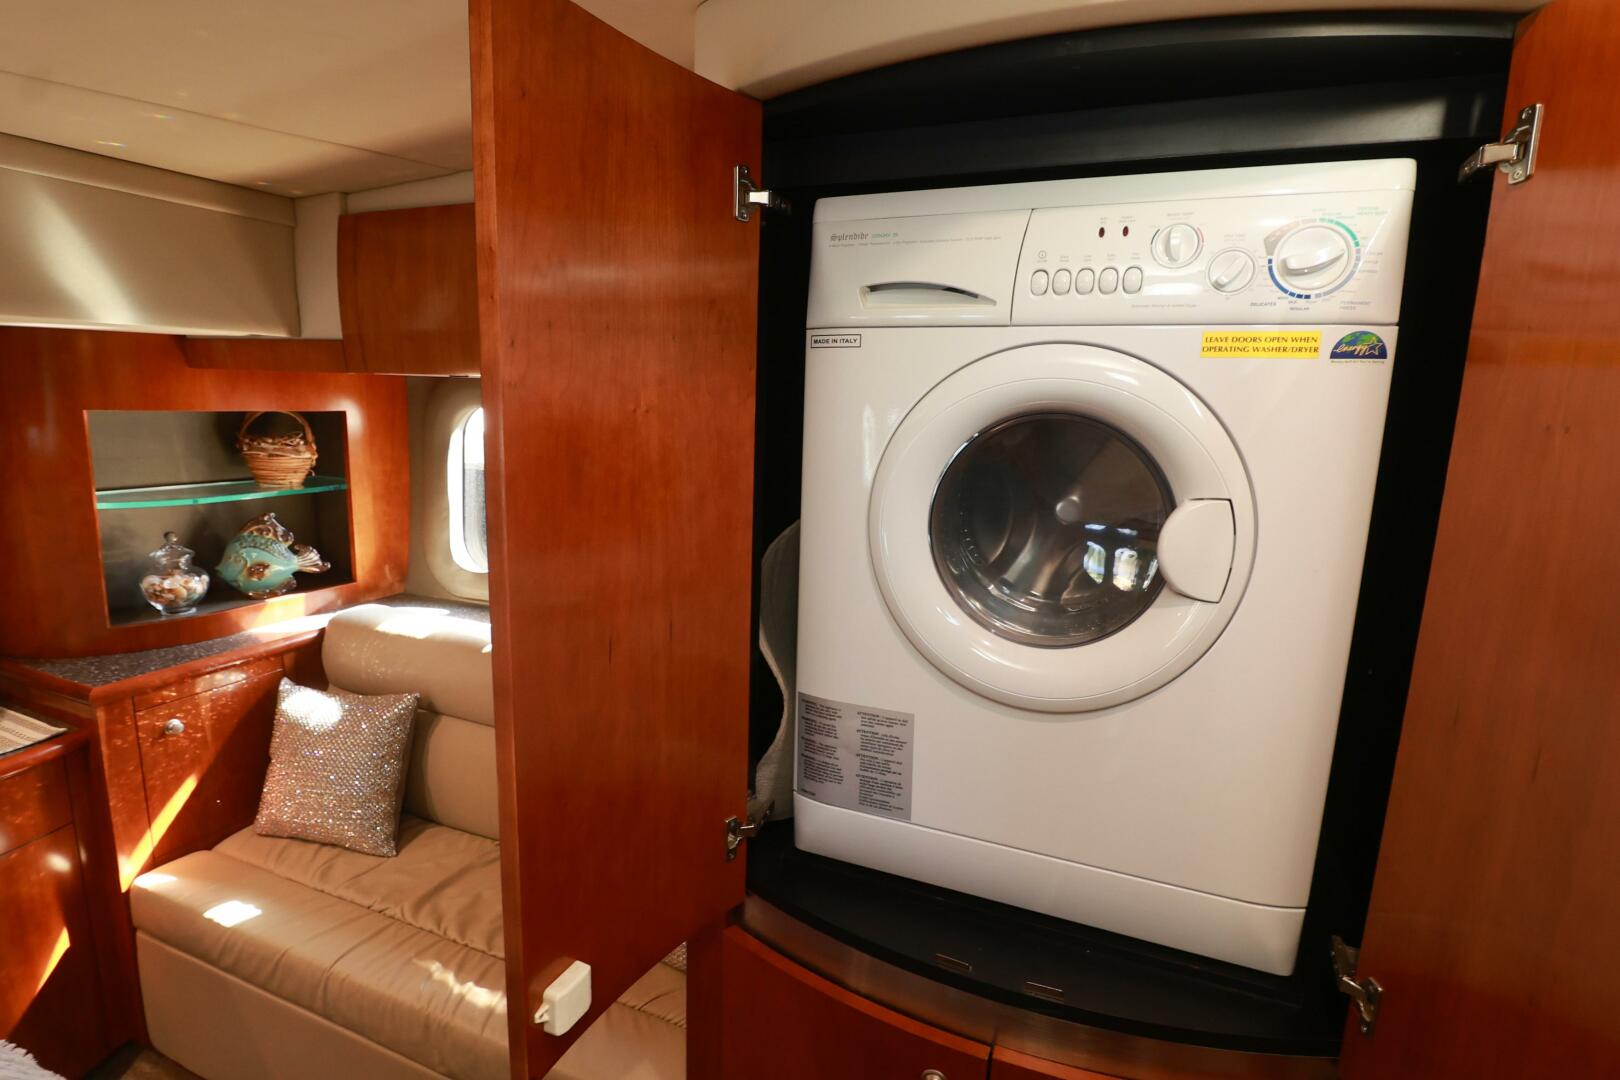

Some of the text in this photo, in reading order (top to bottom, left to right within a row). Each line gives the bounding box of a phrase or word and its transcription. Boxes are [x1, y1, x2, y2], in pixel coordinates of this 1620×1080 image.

[830, 232, 869, 242] Splendide
[1202, 345, 1320, 353] OPERATING WASHER/DRYER
